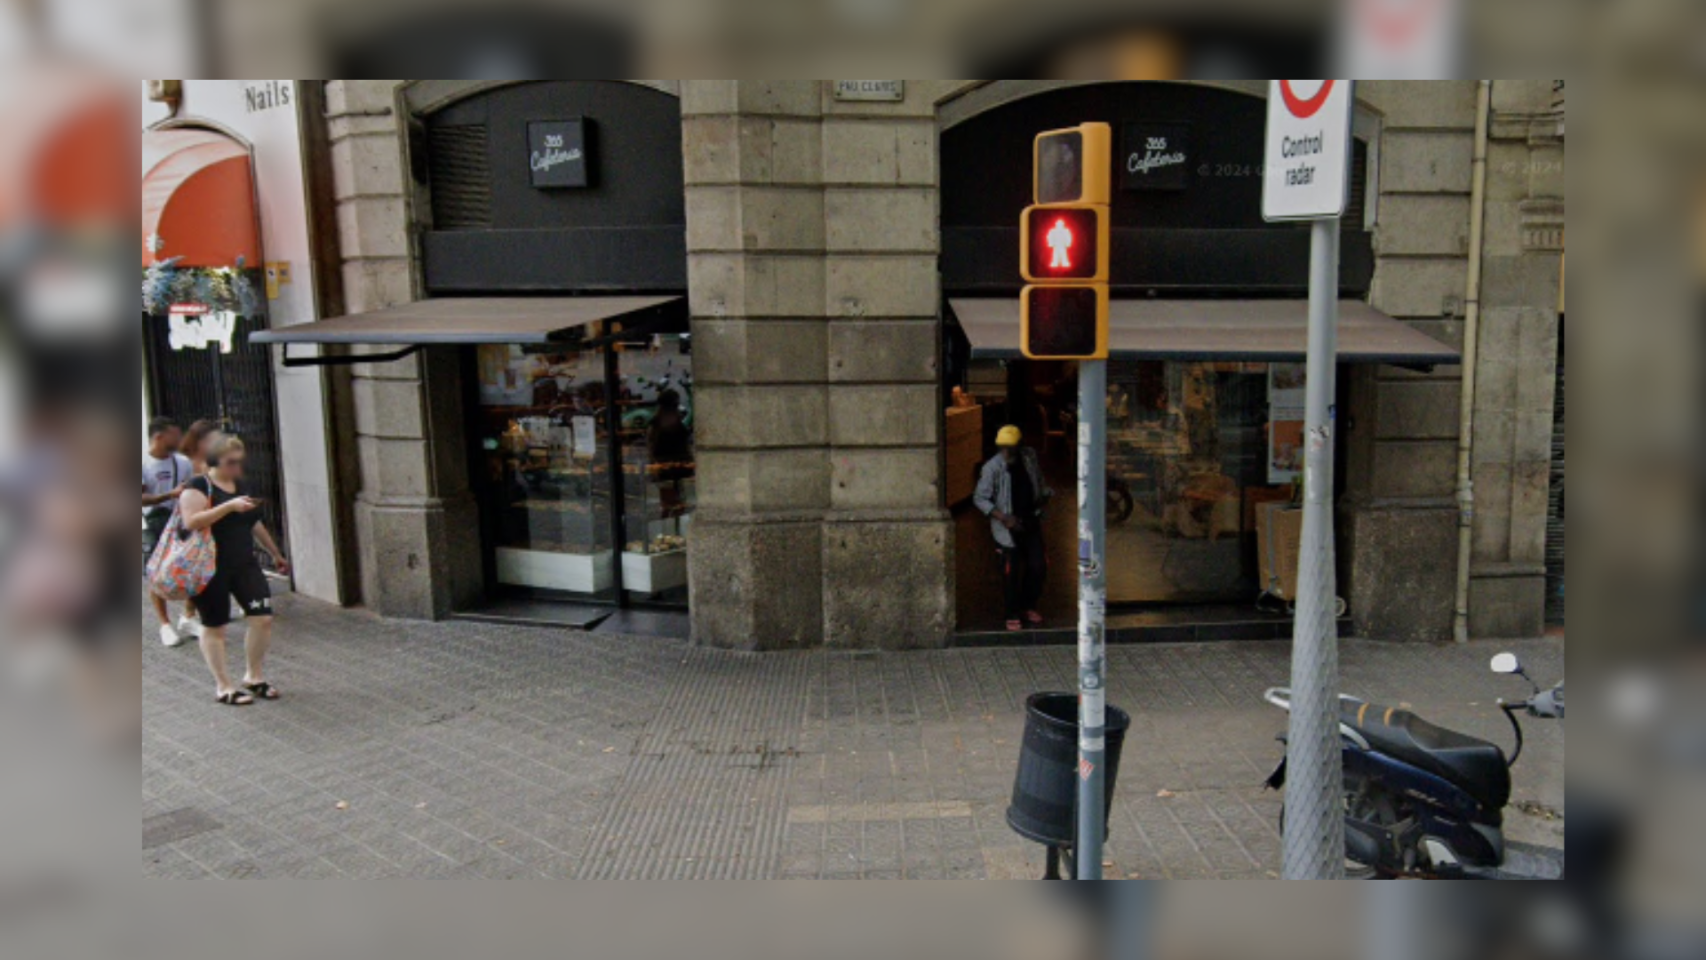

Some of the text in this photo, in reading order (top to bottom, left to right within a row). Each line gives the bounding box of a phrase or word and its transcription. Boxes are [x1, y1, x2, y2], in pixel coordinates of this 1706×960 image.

[245, 80, 290, 113] Nails
[544, 135, 563, 147] 365
[1145, 137, 1167, 149] 365
[1282, 130, 1323, 158] Control
[530, 148, 582, 172] Cafeteria
[1127, 151, 1186, 174] Cafeteria
[1285, 162, 1316, 187] radar
